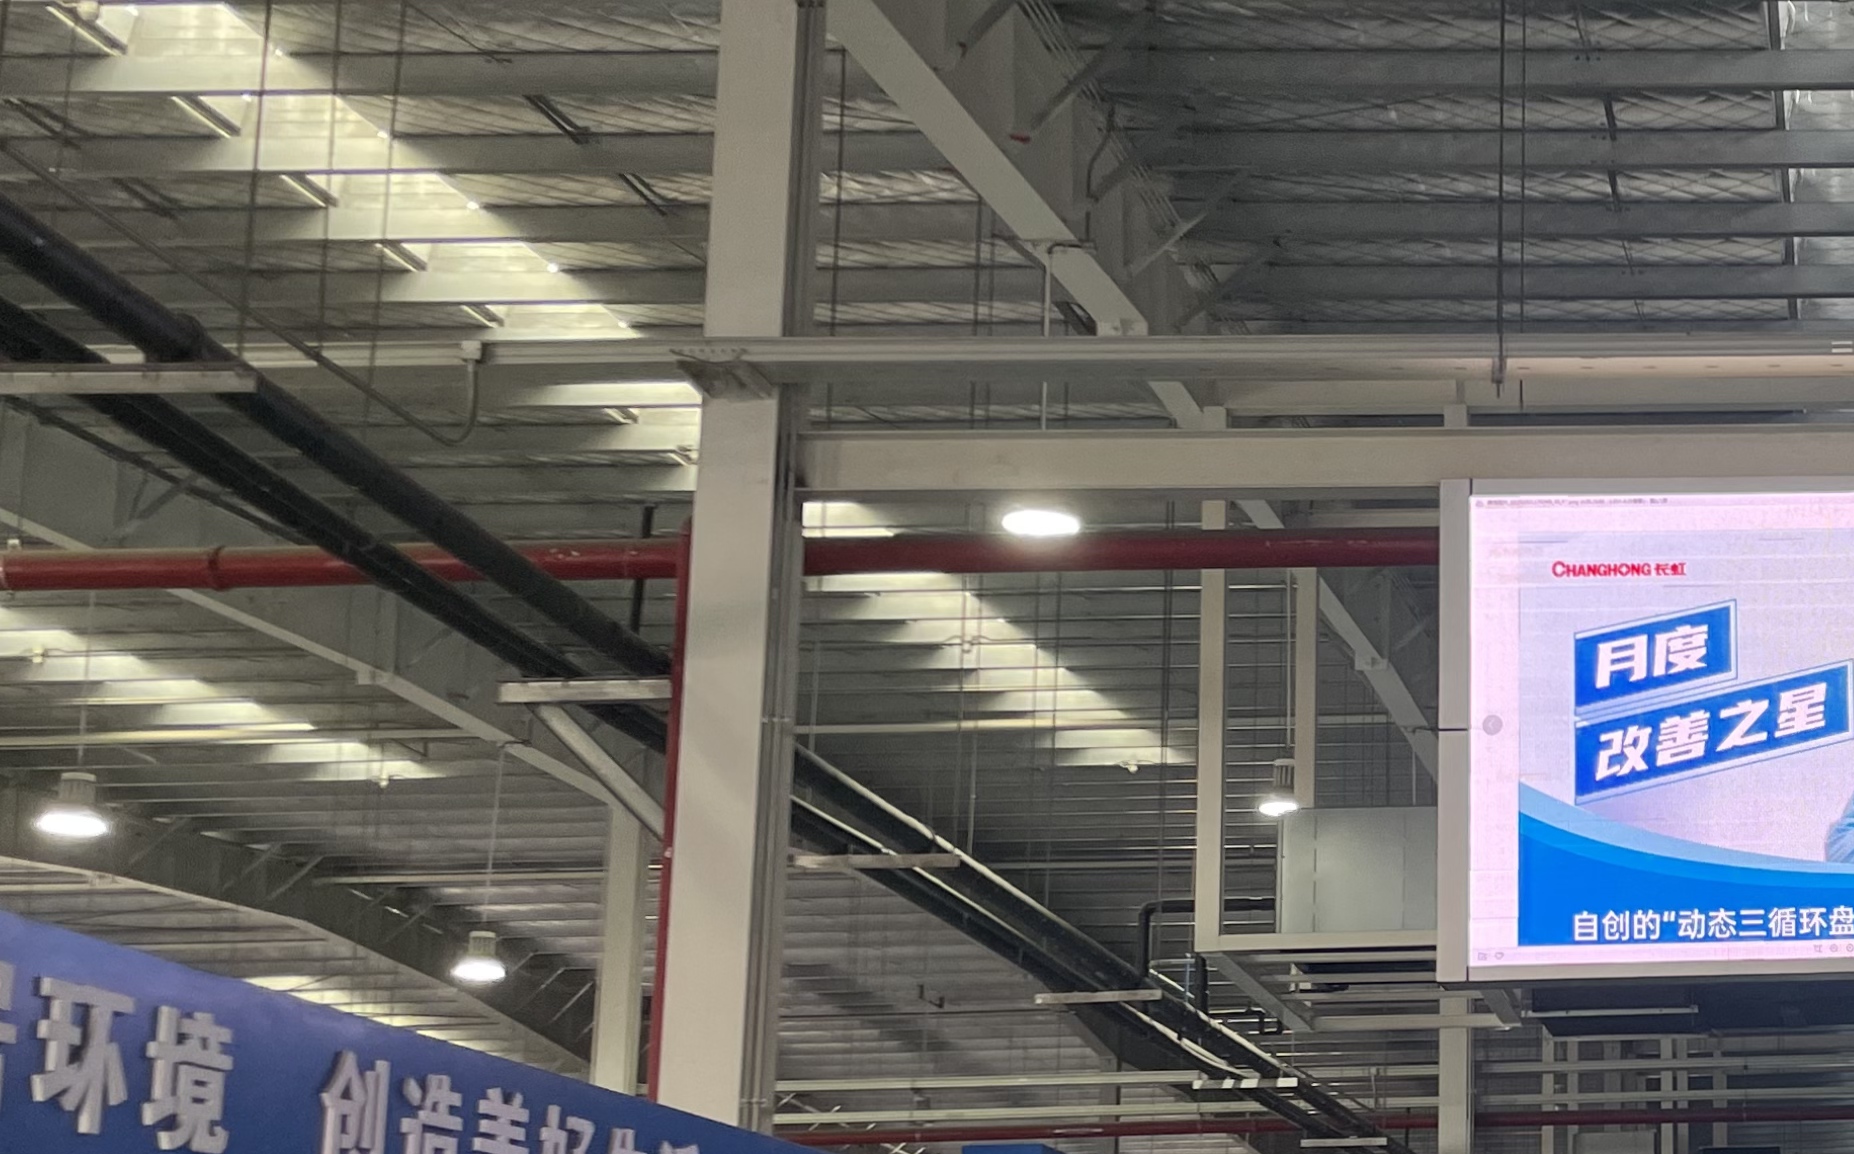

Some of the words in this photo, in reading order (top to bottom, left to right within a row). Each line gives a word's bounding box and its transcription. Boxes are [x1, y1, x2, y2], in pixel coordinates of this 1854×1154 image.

[1552, 560, 1651, 578] CHANGHONG
[1654, 562, 1687, 577] 长虹
[1595, 622, 1709, 690] 月度
[1595, 681, 1828, 782] 改善之星
